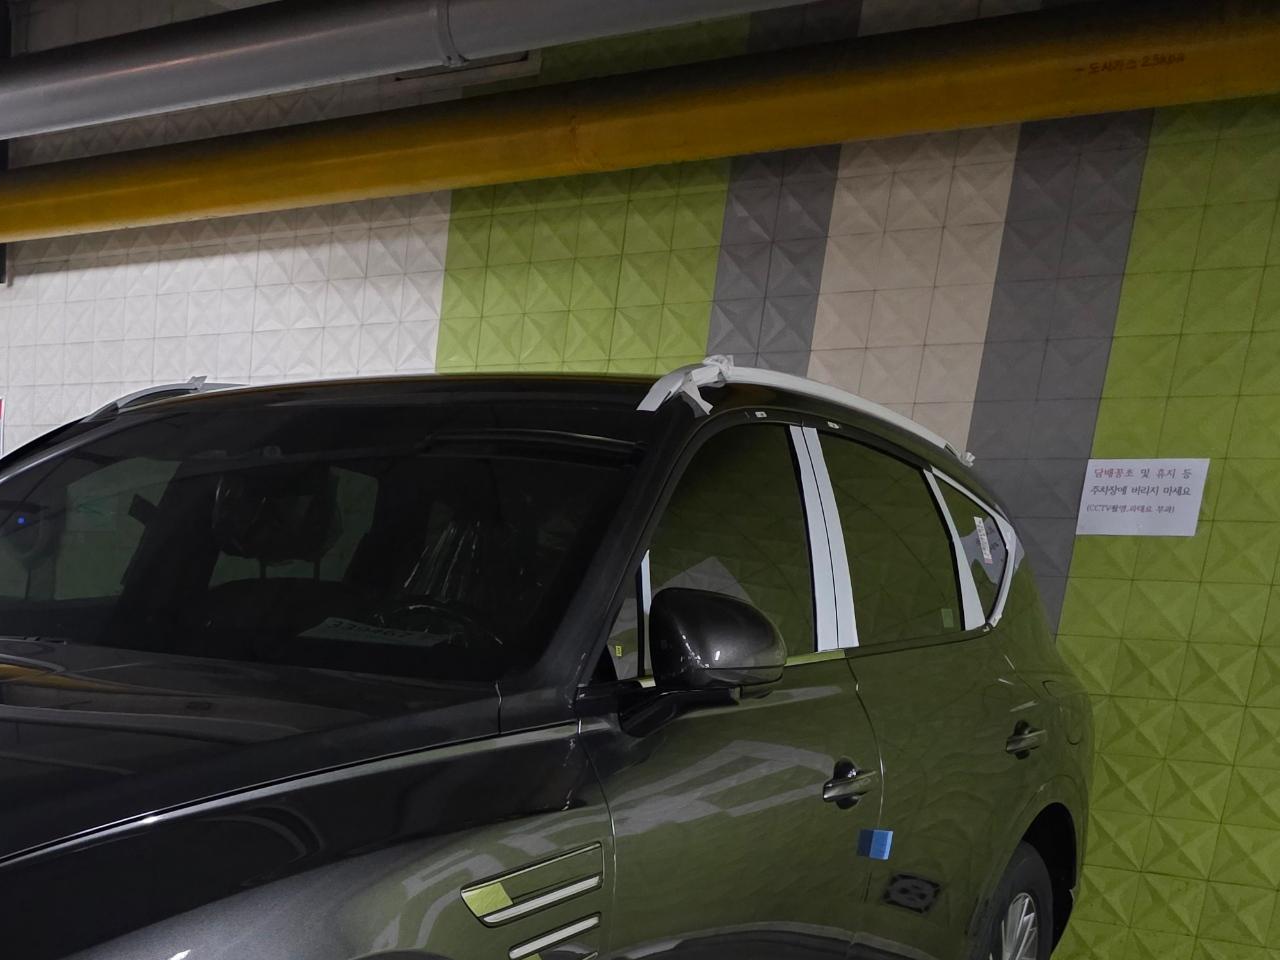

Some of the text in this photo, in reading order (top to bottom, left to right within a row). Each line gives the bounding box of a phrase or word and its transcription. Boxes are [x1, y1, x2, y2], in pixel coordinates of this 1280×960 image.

[1091, 485, 1191, 496] 주차장에 버리지 마세요
